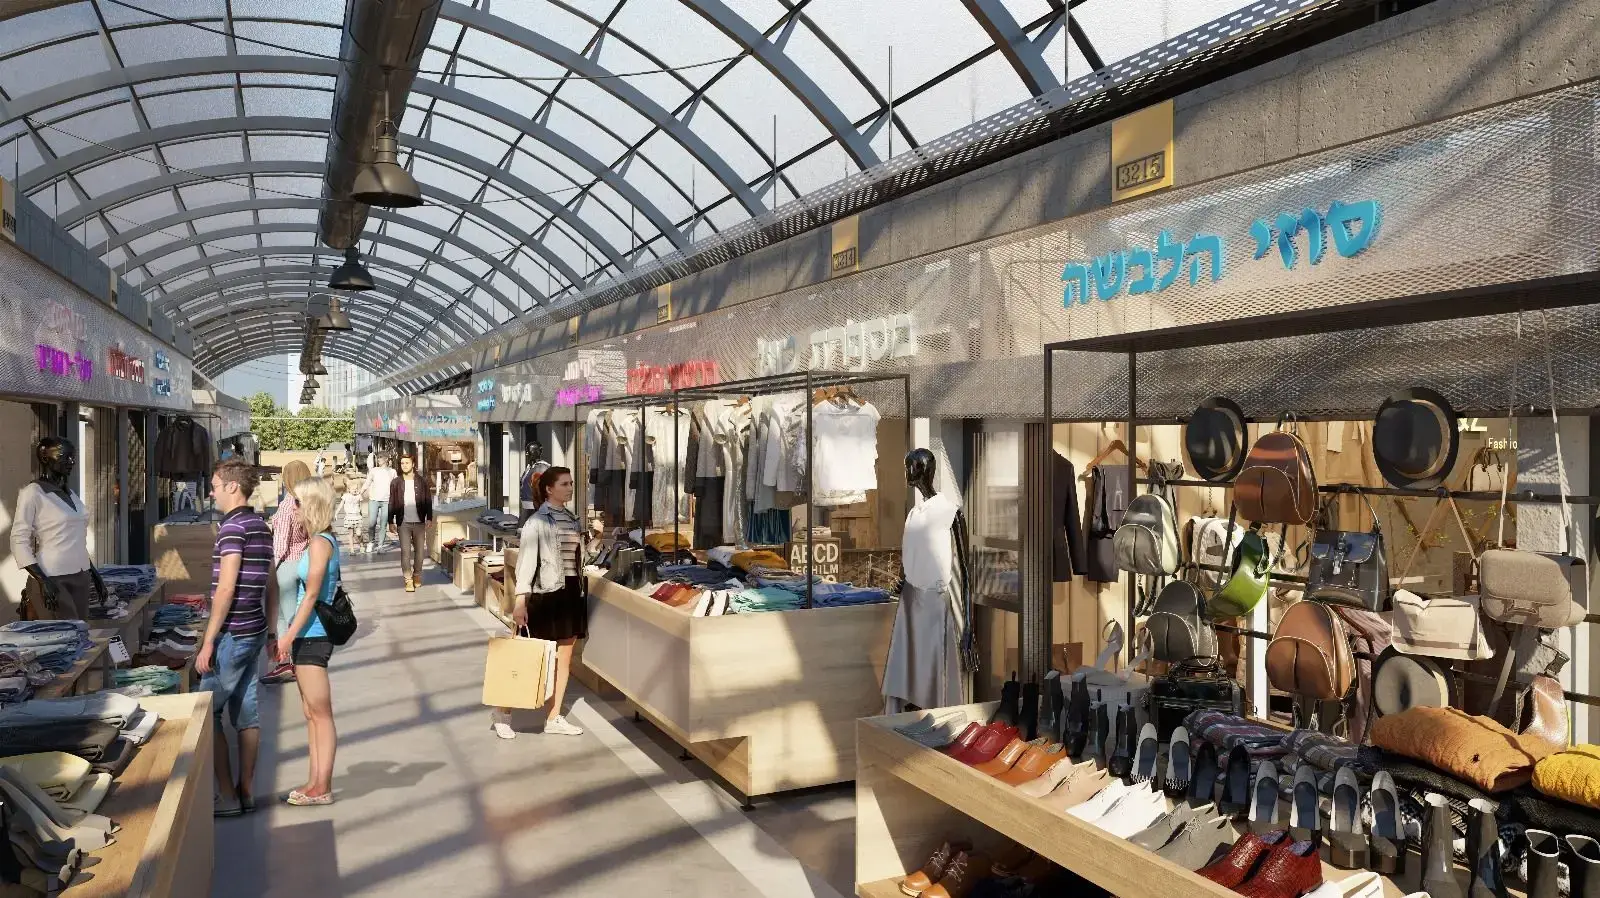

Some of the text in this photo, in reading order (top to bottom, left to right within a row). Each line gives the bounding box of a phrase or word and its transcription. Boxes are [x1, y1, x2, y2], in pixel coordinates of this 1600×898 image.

[1119, 156, 1162, 186] 3215
[1060, 199, 1384, 309] סוזי הלבשה
